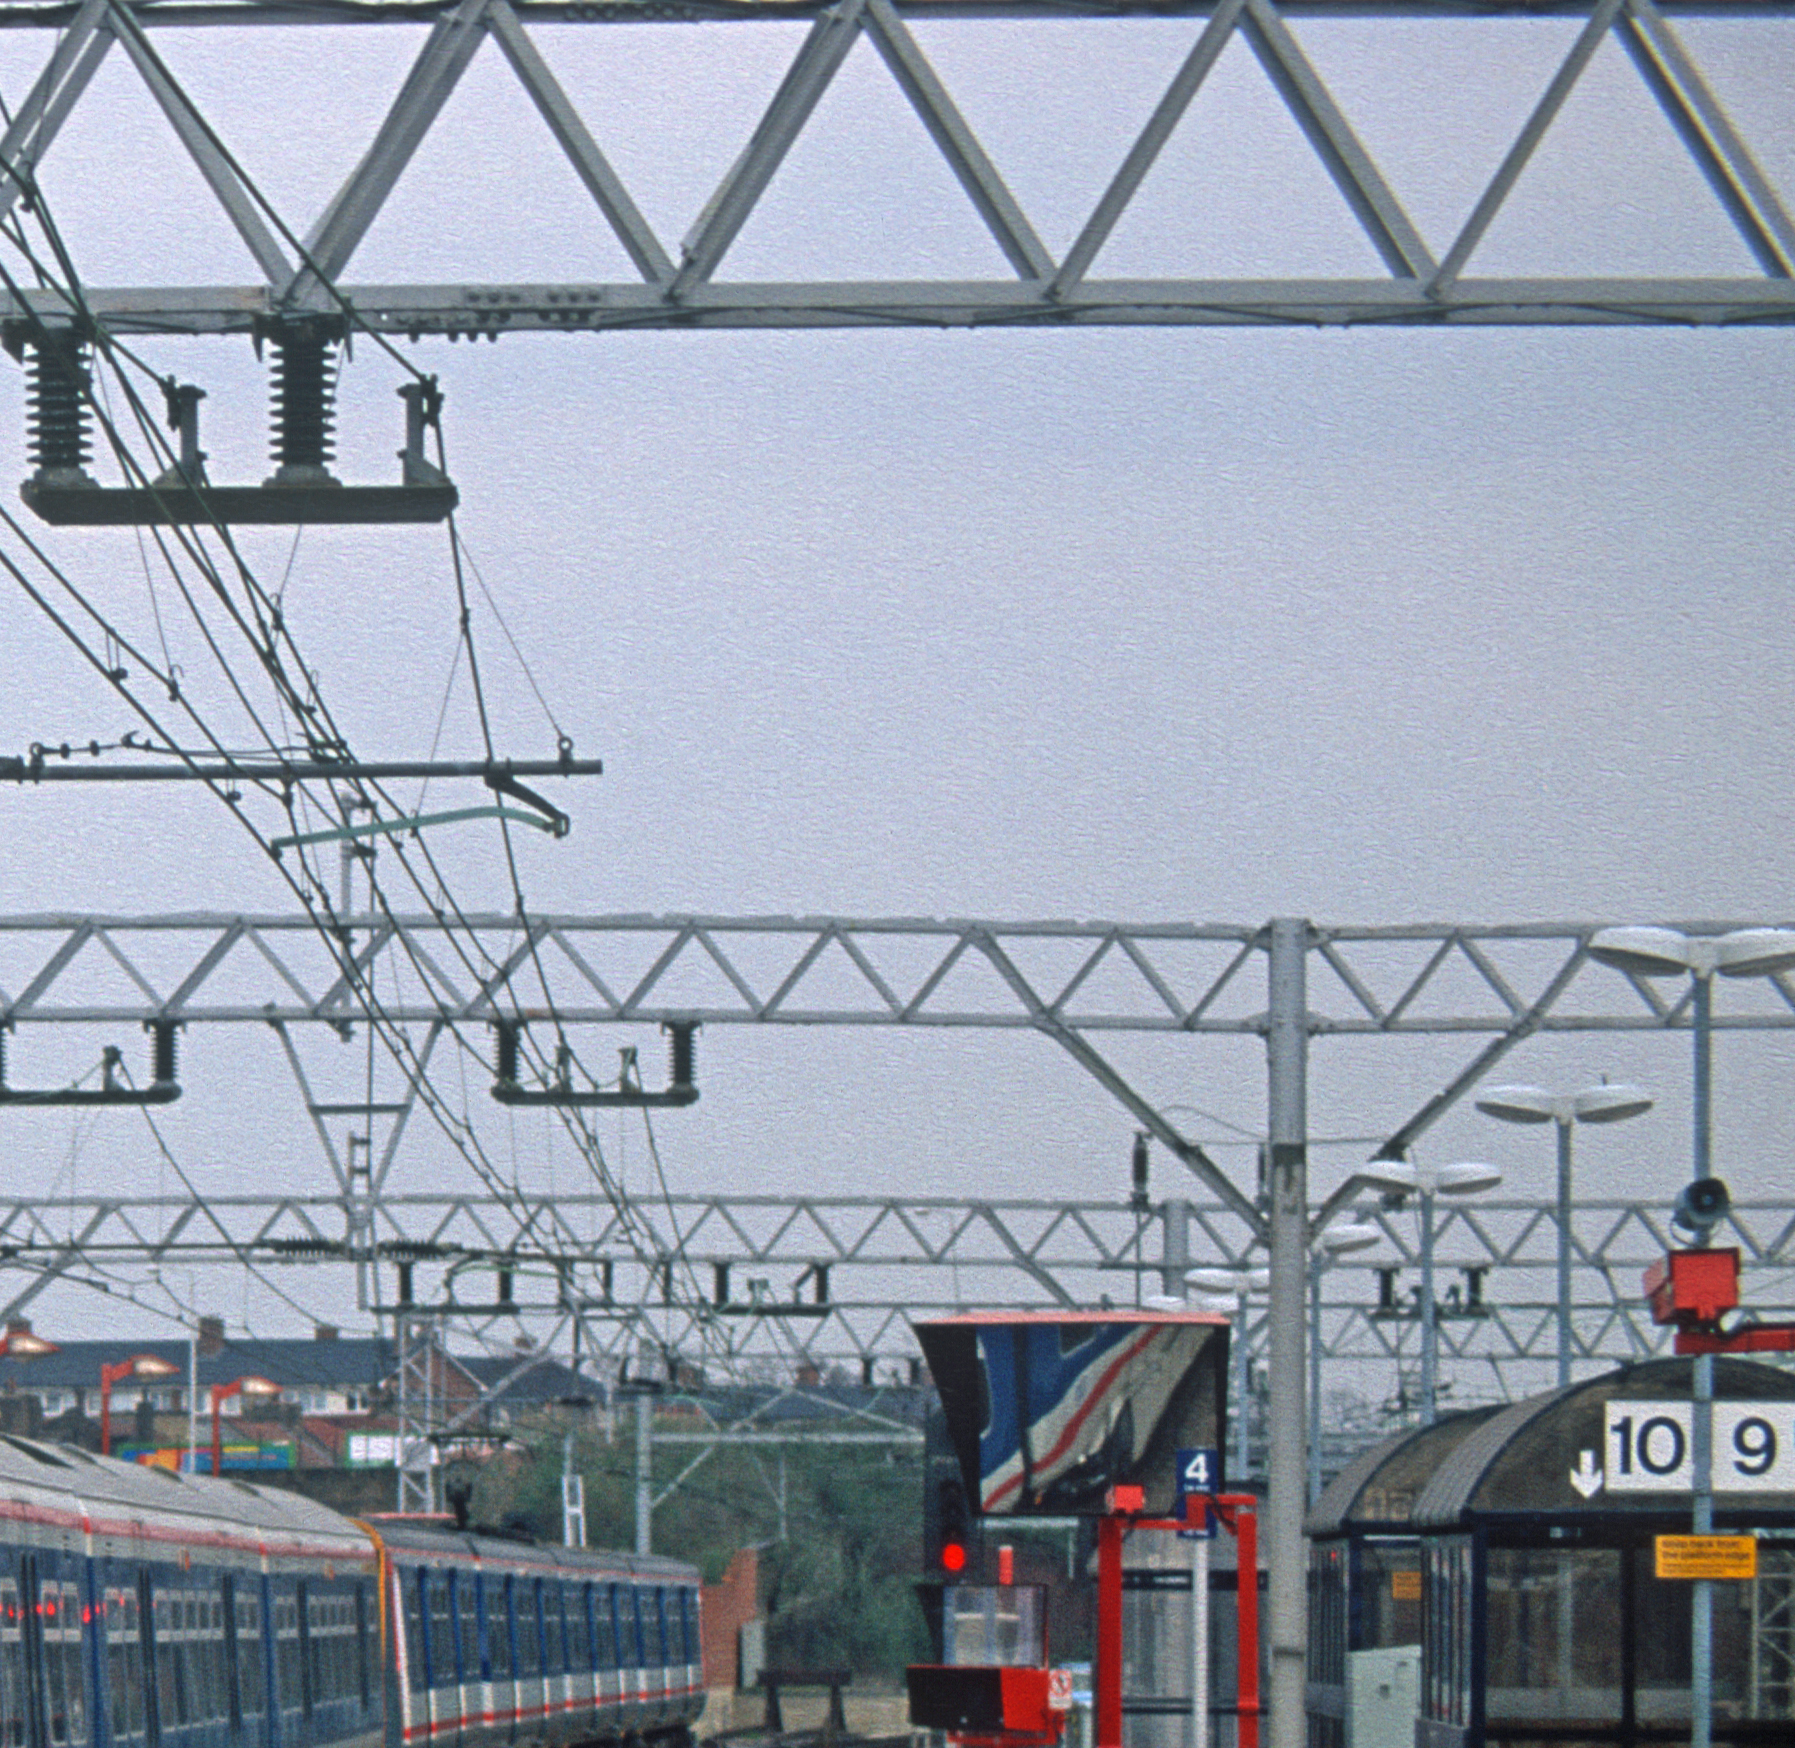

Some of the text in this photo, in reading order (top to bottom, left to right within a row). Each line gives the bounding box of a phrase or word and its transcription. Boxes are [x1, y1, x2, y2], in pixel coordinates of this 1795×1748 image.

[1184, 1452, 1210, 1484] 4
[1610, 1415, 1777, 1476] 10 9
